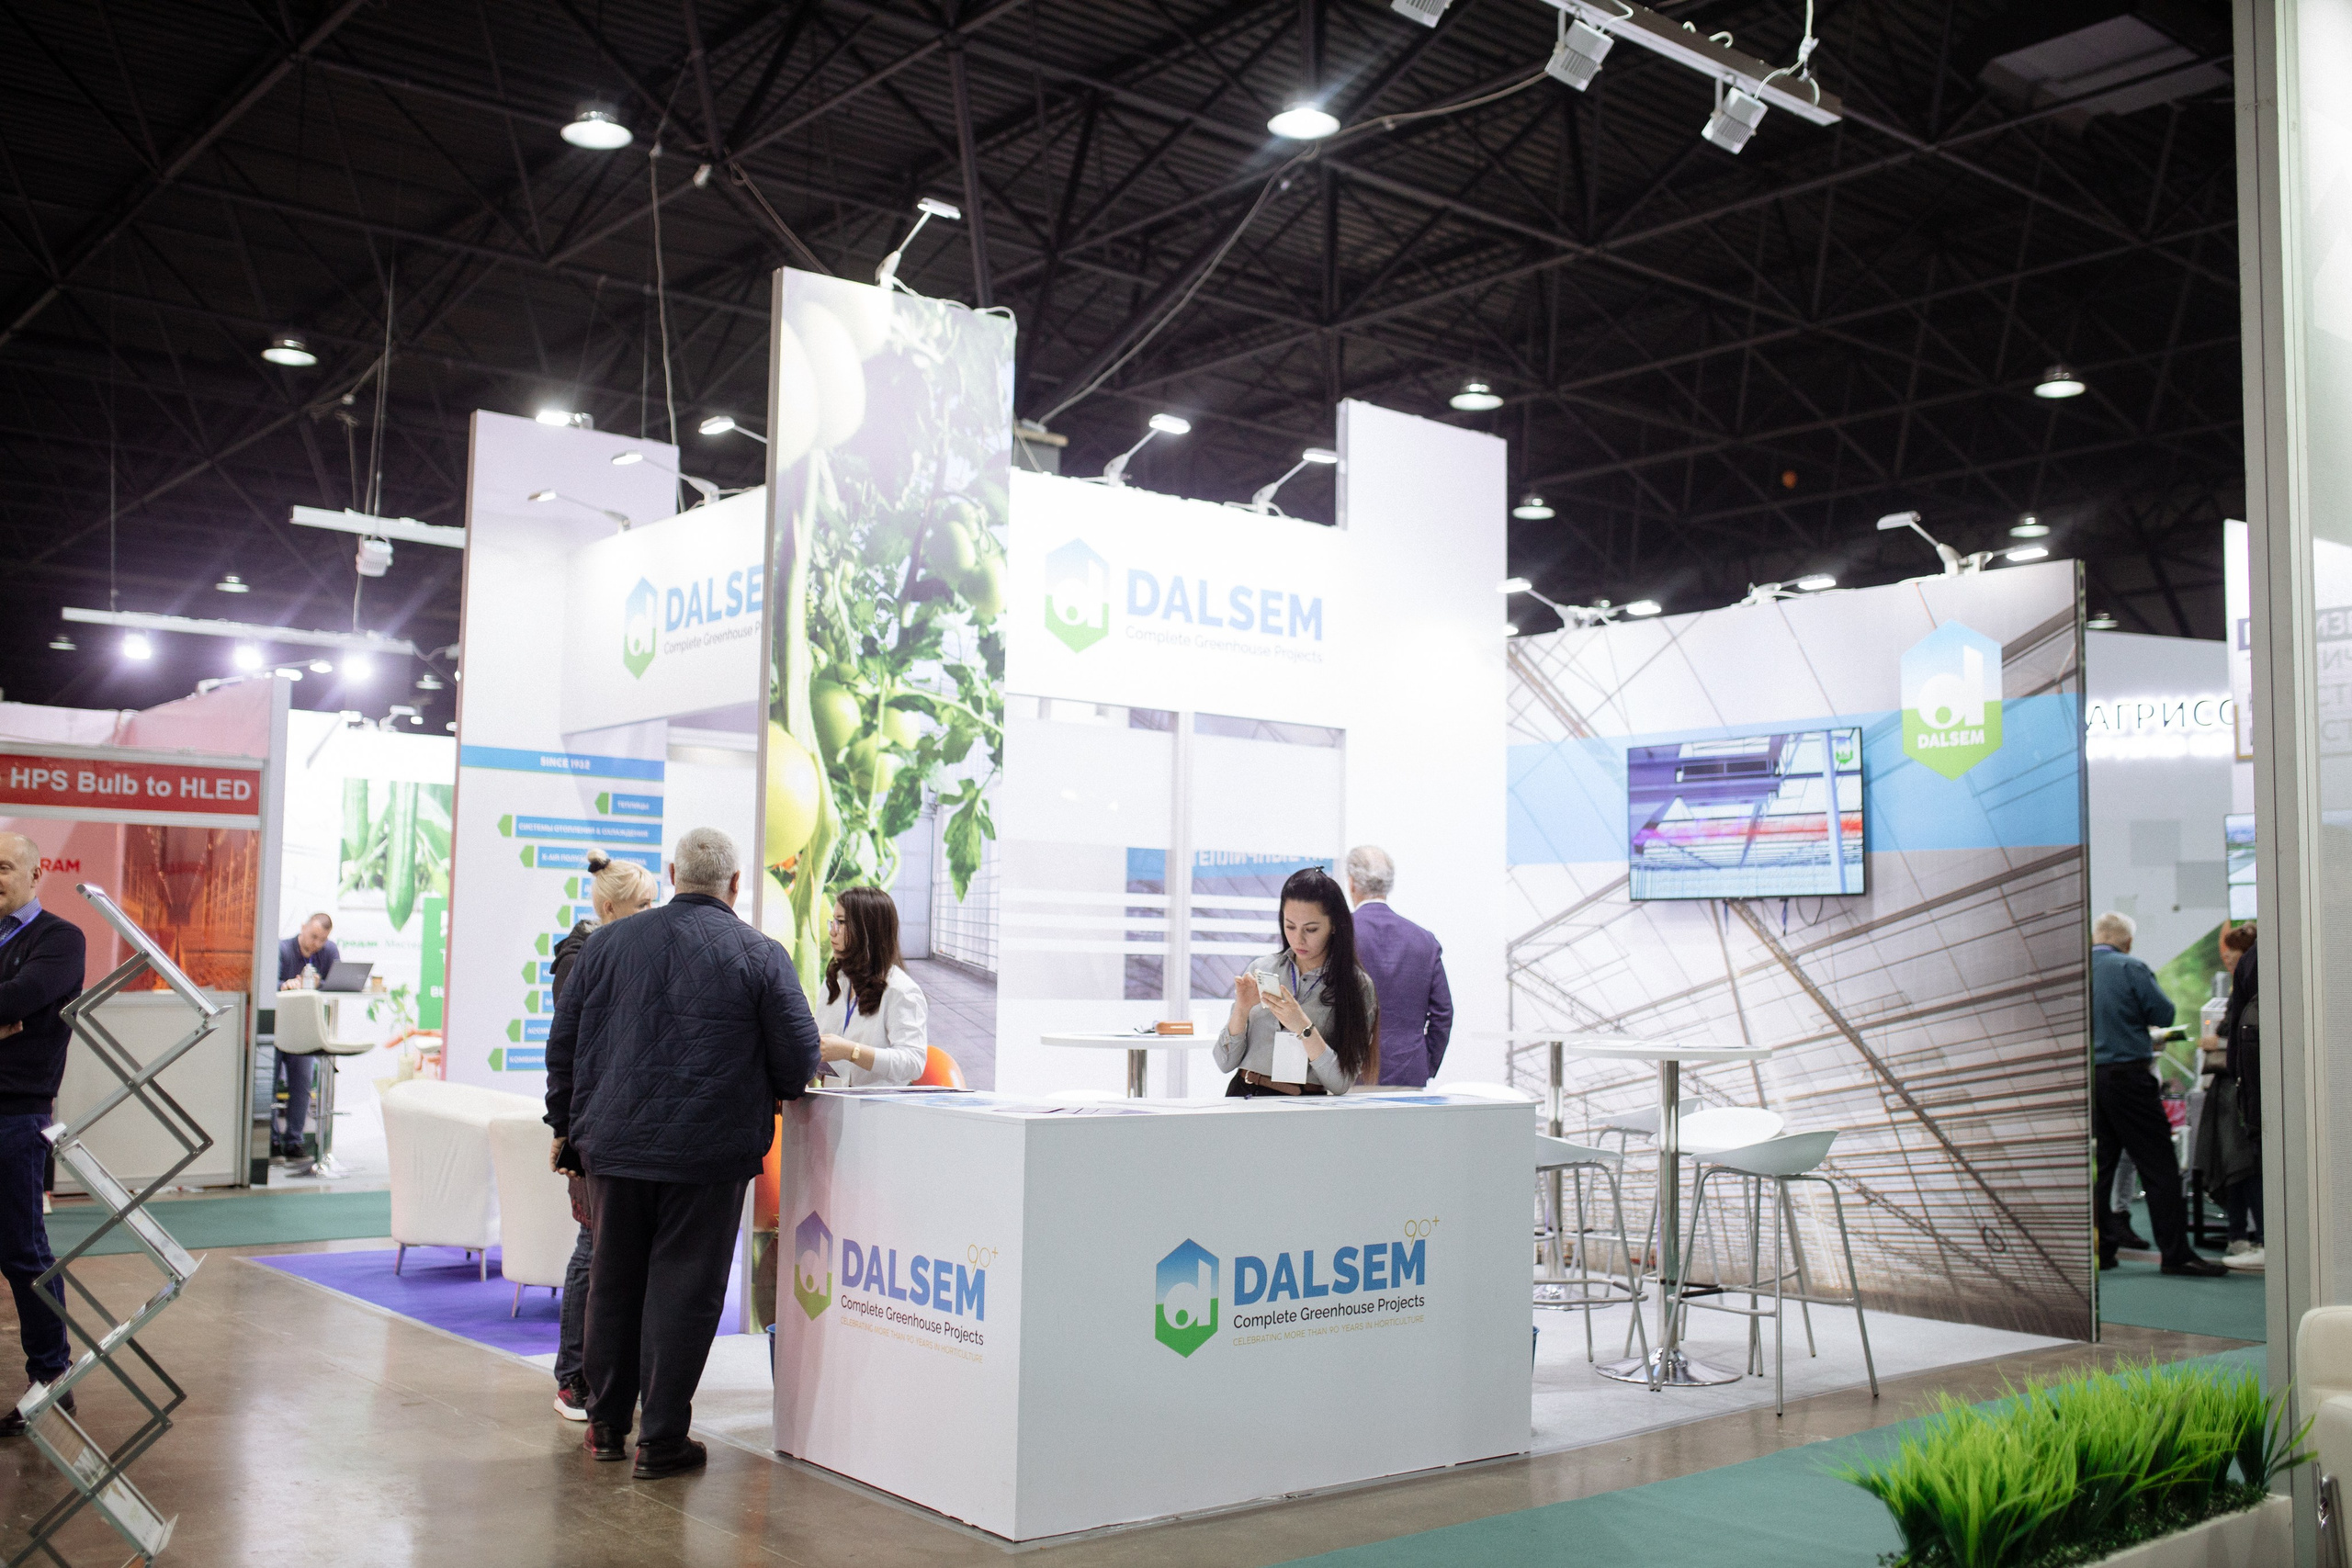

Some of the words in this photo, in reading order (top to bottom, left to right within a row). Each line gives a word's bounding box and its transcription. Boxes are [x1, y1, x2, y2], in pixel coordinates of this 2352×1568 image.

[665, 564, 764, 633] DALSE
[1126, 568, 1323, 641] DALSEM
[663, 635, 702, 655] Complete
[704, 626, 753, 647] Greenhouse
[1125, 625, 1192, 648] Complete
[1194, 635, 1272, 658] Greenhouse
[1273, 645, 1323, 664] Projects
[1917, 729, 1985, 750] DALSEM
[540, 755, 570, 769] SINCE
[9, 766, 69, 793] HPS
[77, 771, 138, 796] Bulb
[145, 775, 173, 797] to
[179, 776, 252, 801] HLED
[40, 858, 80, 873] RAM
[842, 1238, 986, 1322] DALSEM
[1234, 1239, 1426, 1306] DALSEM
[841, 1294, 884, 1318] Complete
[886, 1306, 942, 1335] Greenhouse
[944, 1321, 984, 1346] Projects
[1233, 1309, 1297, 1329] Complete
[1300, 1303, 1375, 1321] Greenhouse
[1377, 1294, 1426, 1314] Projects
[840, 1316, 874, 1333] CELEBRATING
[874, 1326, 889, 1337] MORE
[890, 1329, 906, 1341] THAN
[915, 1337, 933, 1350] YEARS
[934, 1342, 940, 1351] IN
[941, 1344, 984, 1364] HORTICULTURE
[1232, 1333, 1283, 1347] CELEBRATING
[1283, 1328, 1306, 1340] MORE
[1307, 1327, 1328, 1337] THAN
[1329, 1325, 1340, 1334] 90
[1341, 1322, 1364, 1332] YEARS
[1365, 1321, 1373, 1330] IN
[1374, 1314, 1425, 1328] HORTICULTURE
